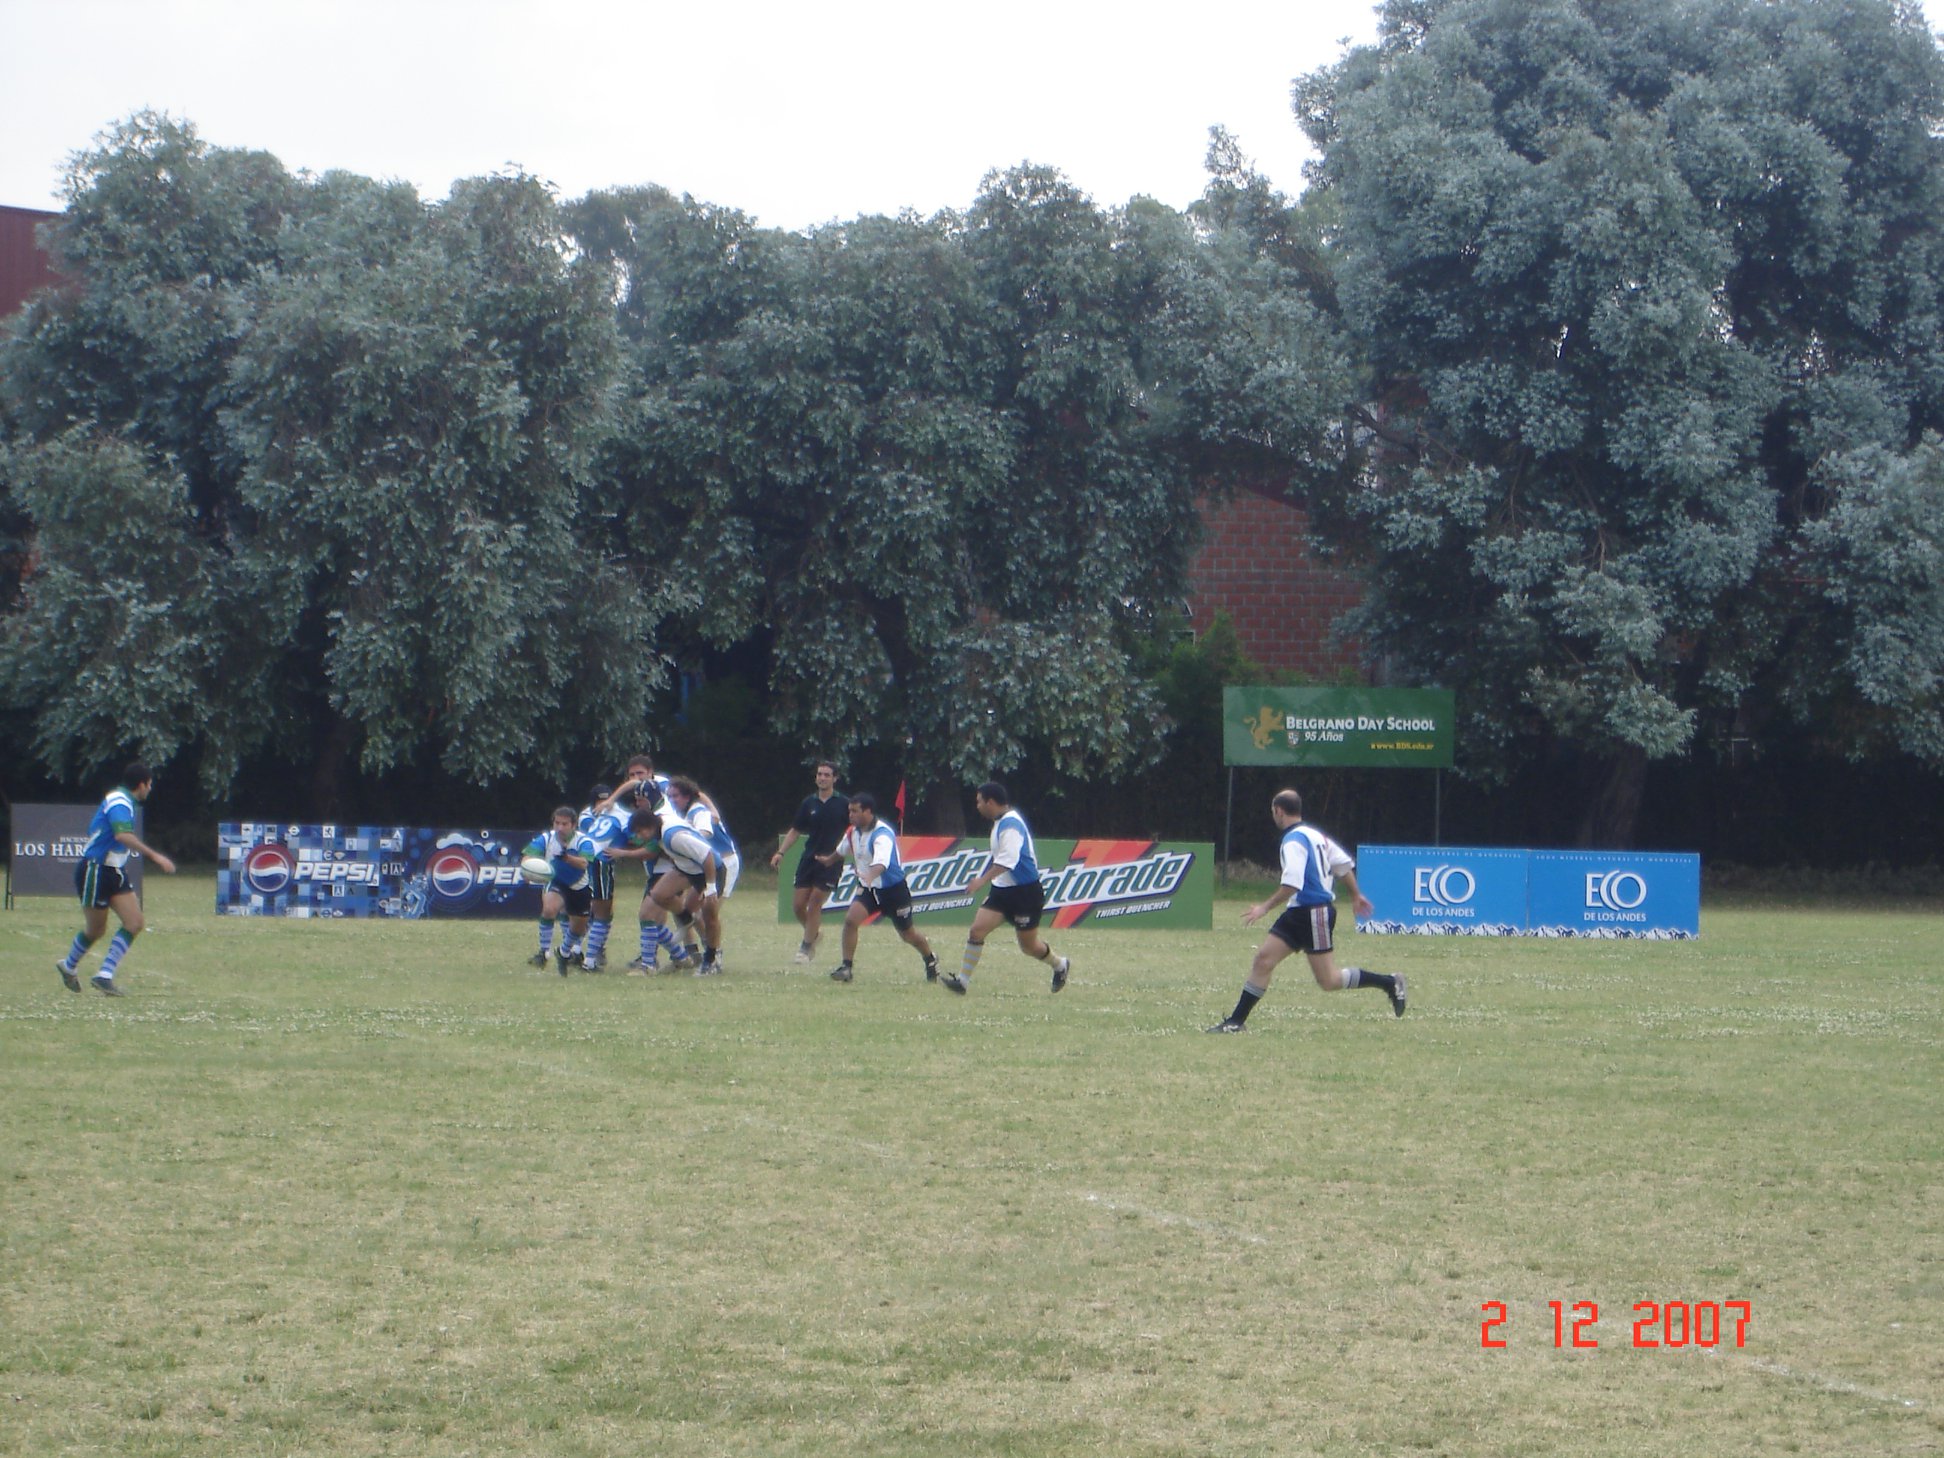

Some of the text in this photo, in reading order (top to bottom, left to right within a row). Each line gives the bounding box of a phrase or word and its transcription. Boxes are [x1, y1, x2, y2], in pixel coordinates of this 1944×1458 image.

[1286, 716, 1435, 731] BELGRANO DAY SCHOOL
[1305, 731, 1344, 741] 95 Años
[15, 843, 85, 857] LOS HAR
[294, 862, 374, 883] PEPSI
[1040, 852, 1190, 906] atorade
[1413, 864, 1476, 907] ECO
[1585, 869, 1647, 911] ECO
[928, 897, 974, 911] QUENCHER
[1096, 900, 1171, 918] THIRST QUENCHER
[1412, 907, 1475, 918] DE LOS ANDES
[1584, 912, 1647, 923] DE LOS ANDES
